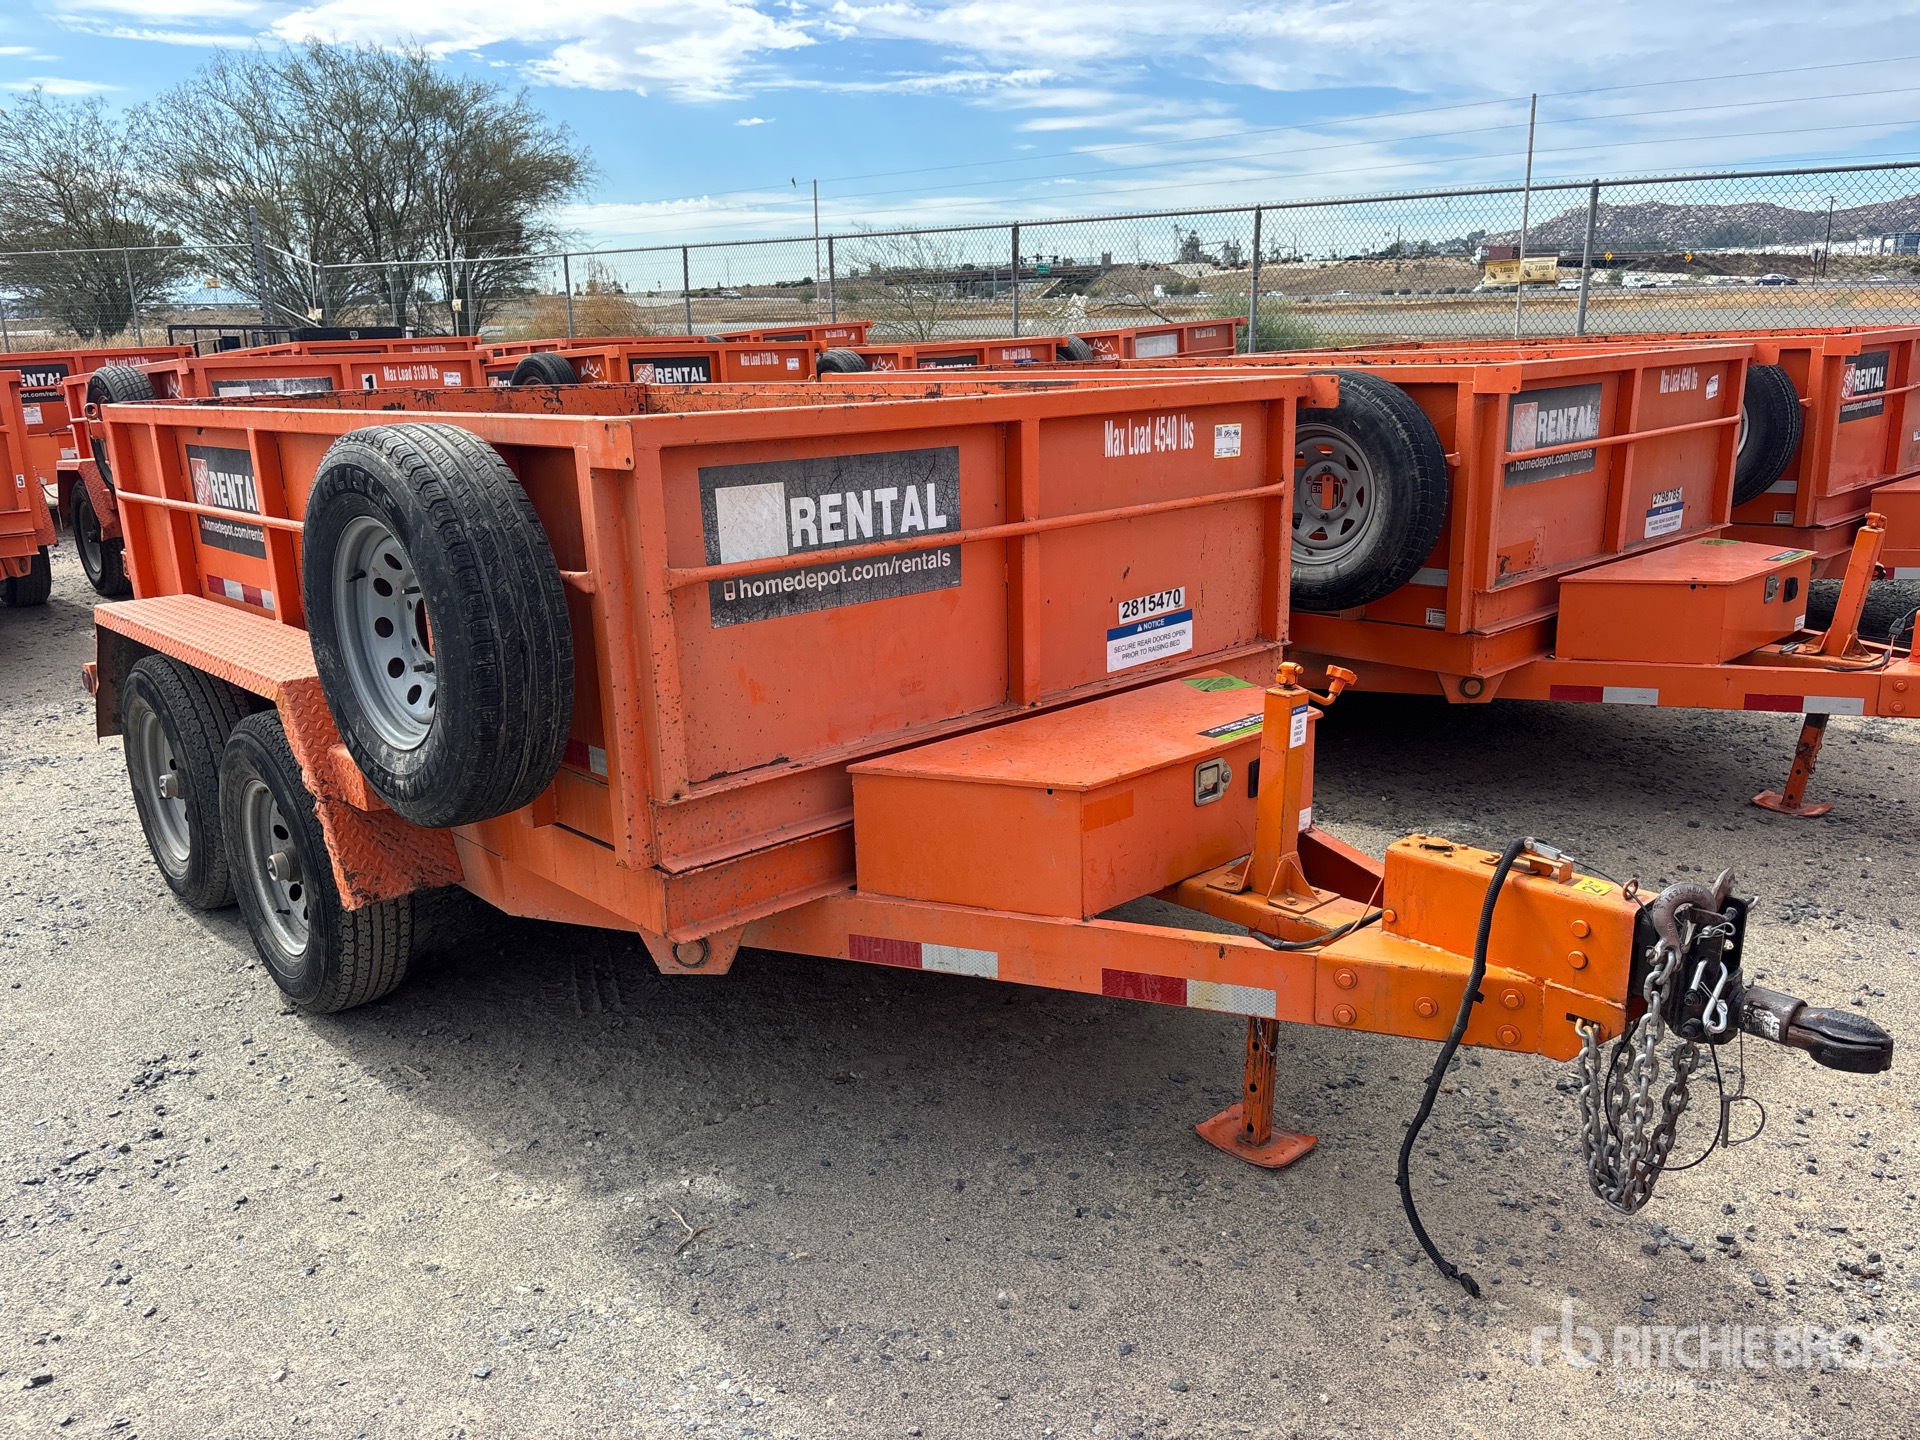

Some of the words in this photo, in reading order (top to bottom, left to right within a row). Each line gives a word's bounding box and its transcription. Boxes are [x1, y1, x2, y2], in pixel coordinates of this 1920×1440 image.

[21, 372, 60, 387] ENTA
[364, 374, 374, 389] 1
[383, 365, 397, 382] Max
[397, 365, 412, 381] Load
[412, 364, 428, 381] 3130
[428, 364, 439, 380] lbs
[655, 366, 707, 384] RENTAL
[1854, 365, 1885, 392] RENTAL
[1104, 420, 1125, 458] Max
[1128, 418, 1151, 456] Load
[1154, 414, 1178, 453] 4540
[1180, 413, 1195, 450] lbs
[1537, 404, 1598, 443] RENTAL
[1515, 448, 1593, 472] homedepot.com/rentals
[17, 475, 24, 487] 5
[789, 482, 947, 548] RENTAL
[740, 550, 951, 599] homedepot.com/rentals
[1121, 588, 1181, 620] 2815470
[1143, 618, 1165, 631] NOTICE
[1113, 641, 1136, 654] SECURE
[1137, 638, 1152, 647] REAR
[1152, 632, 1171, 644] DOORS
[1171, 629, 1187, 639] OPEN
[1122, 651, 1139, 660] PRIOR
[1148, 642, 1169, 653] RAISING
[1169, 639, 1180, 648] BED
